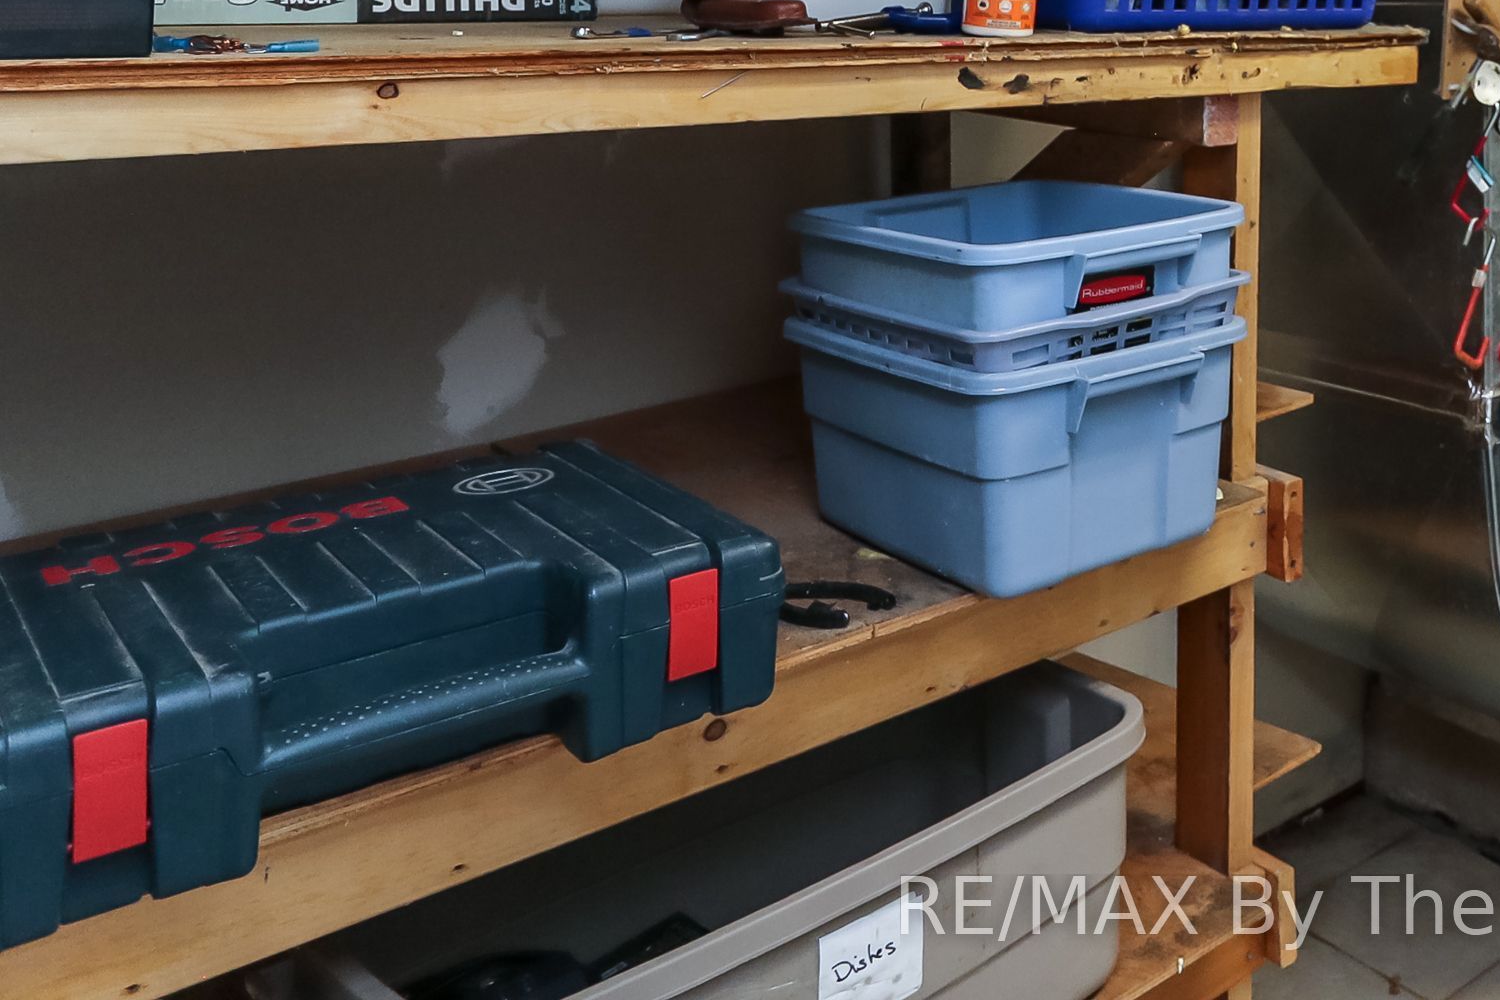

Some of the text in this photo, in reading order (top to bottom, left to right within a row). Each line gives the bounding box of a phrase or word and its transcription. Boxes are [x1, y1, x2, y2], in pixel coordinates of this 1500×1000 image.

[1082, 279, 1144, 298] Rubbermaid
[40, 496, 410, 587] BOSCH
[831, 941, 897, 983] Dishes
